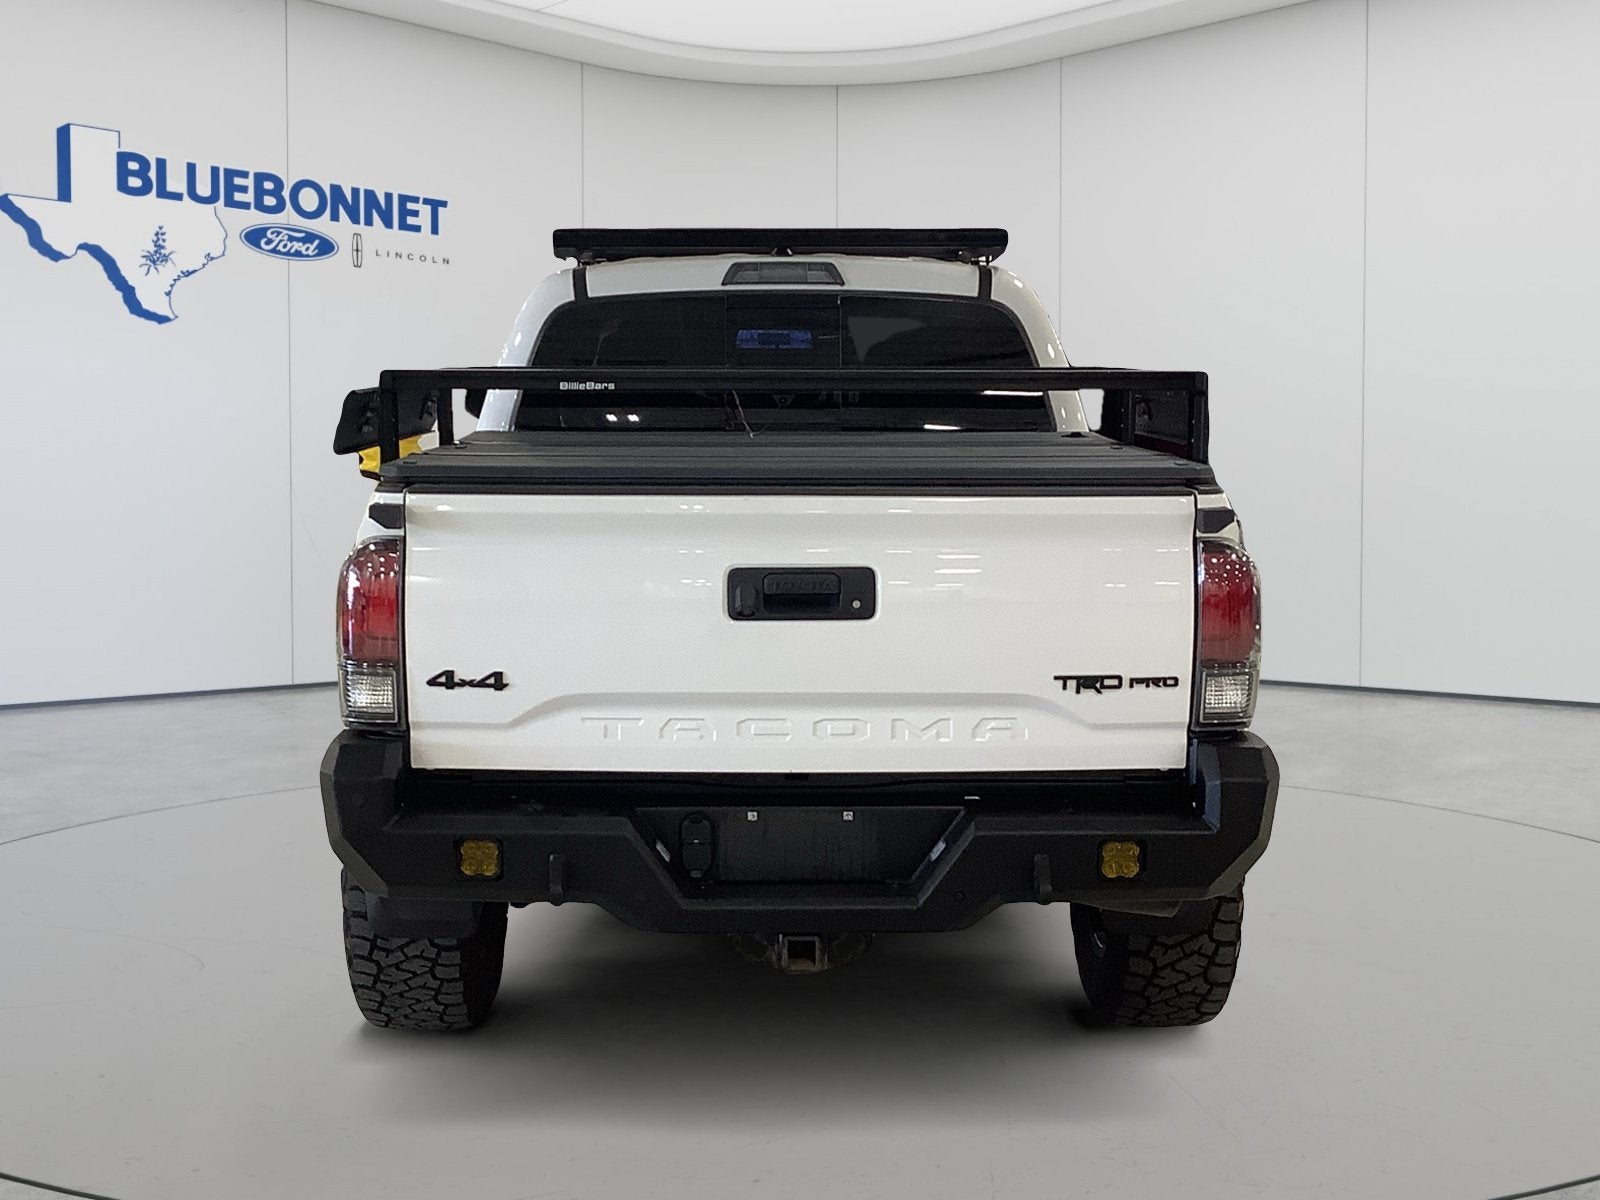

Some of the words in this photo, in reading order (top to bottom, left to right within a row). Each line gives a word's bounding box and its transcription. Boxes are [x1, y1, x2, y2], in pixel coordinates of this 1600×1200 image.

[116, 150, 448, 236] BLUEBONNET
[260, 225, 320, 257] Ford
[375, 249, 451, 266] LINCOLN
[768, 578, 834, 592] TOYOTA
[1053, 674, 1123, 695] TRD
[1128, 676, 1179, 689] PRO
[580, 716, 1029, 742] TACOMA
